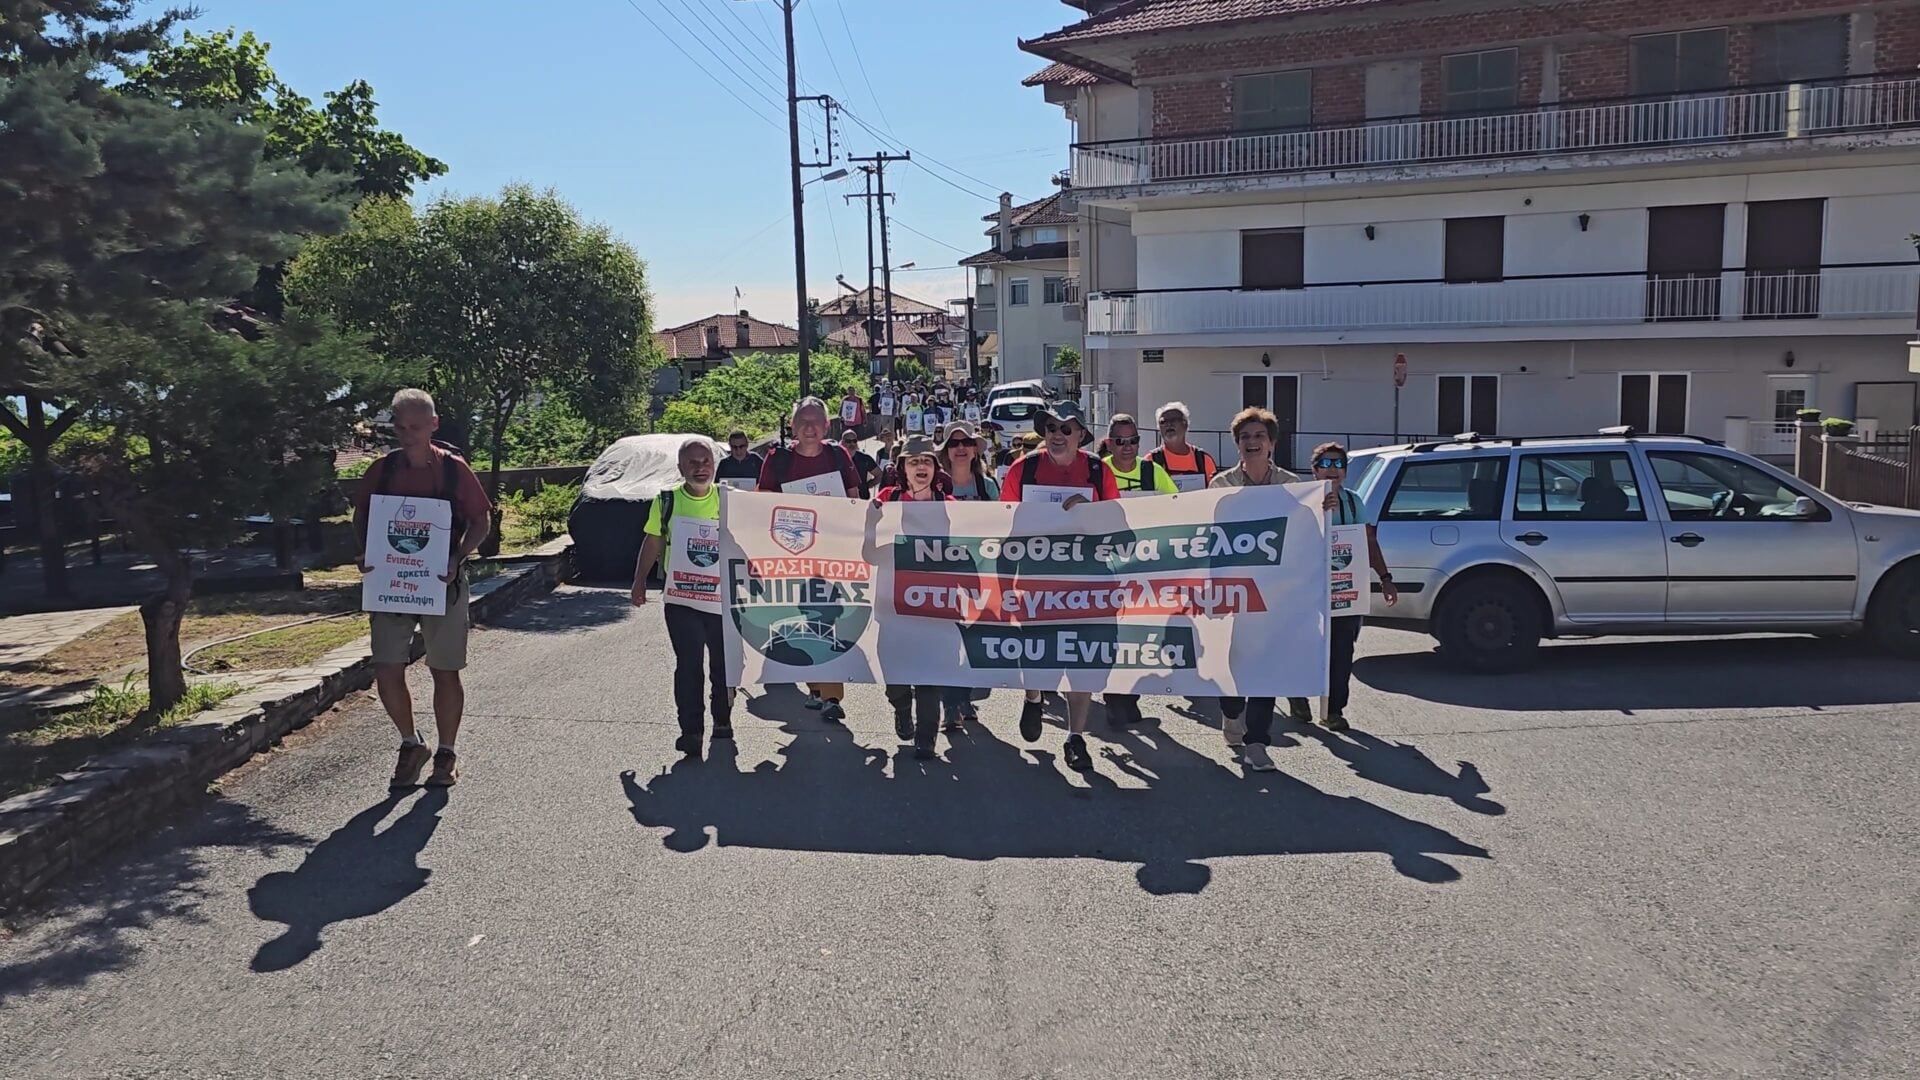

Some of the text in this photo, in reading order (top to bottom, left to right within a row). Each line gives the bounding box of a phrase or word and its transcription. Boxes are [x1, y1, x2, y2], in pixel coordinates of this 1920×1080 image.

[387, 520, 430, 537] ΕΝΙΠΕΑΣ
[914, 526, 1278, 562] Να δοθεί ένα τέλος
[397, 567, 430, 580] αρκετά
[750, 560, 869, 578] ΔΡΑΣΗ ΤΩΡΑ
[390, 580, 419, 592] με την
[728, 559, 871, 605] ΕΝΙΠΕΑΣ
[378, 593, 434, 607] εγκατάληψη
[694, 593, 721, 601] φροντίδ
[904, 578, 1248, 618] στην εγκατάλειψη
[981, 631, 1186, 667] του Ενιπέα
